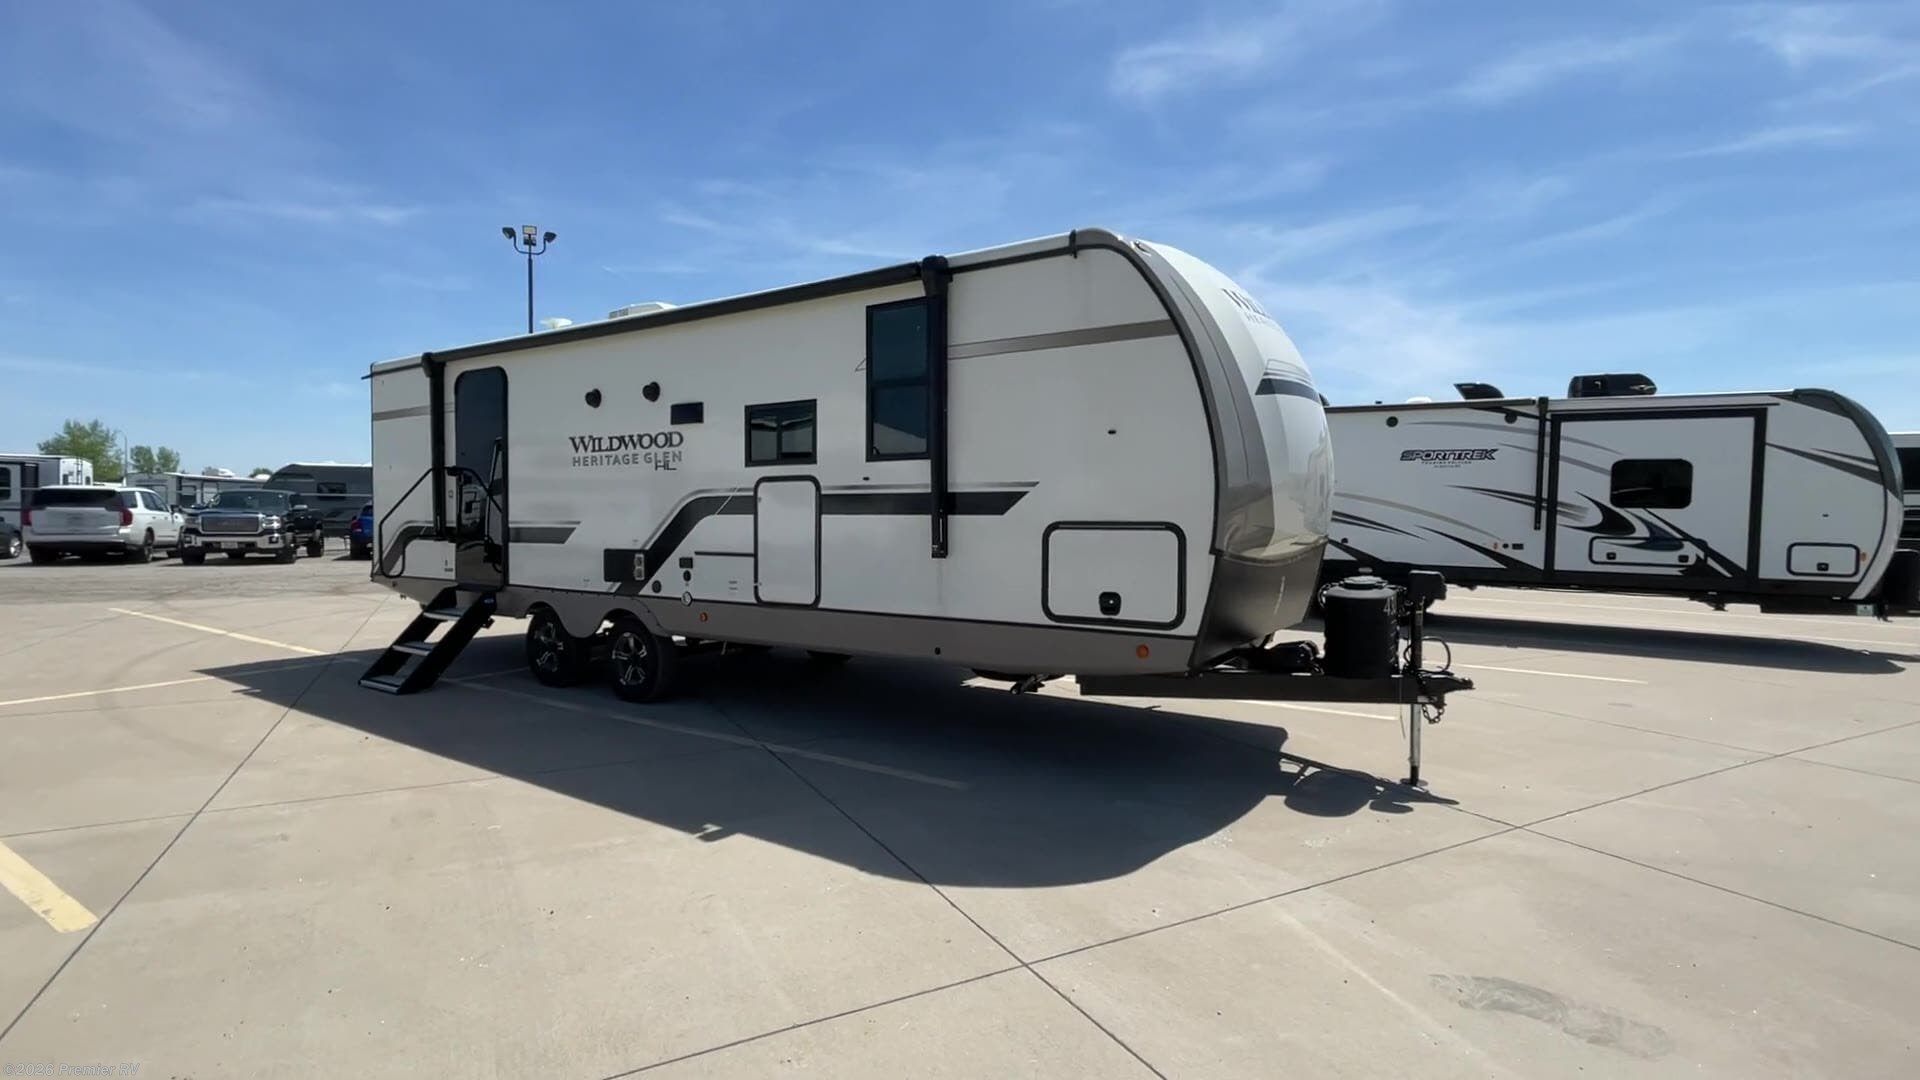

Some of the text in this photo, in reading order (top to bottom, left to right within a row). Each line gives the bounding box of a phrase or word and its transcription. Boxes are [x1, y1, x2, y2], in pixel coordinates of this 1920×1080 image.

[569, 431, 684, 453] WILDWOOD
[572, 450, 683, 467] HERITAGE GLEN
[1400, 449, 1499, 461] SPORTTREK
